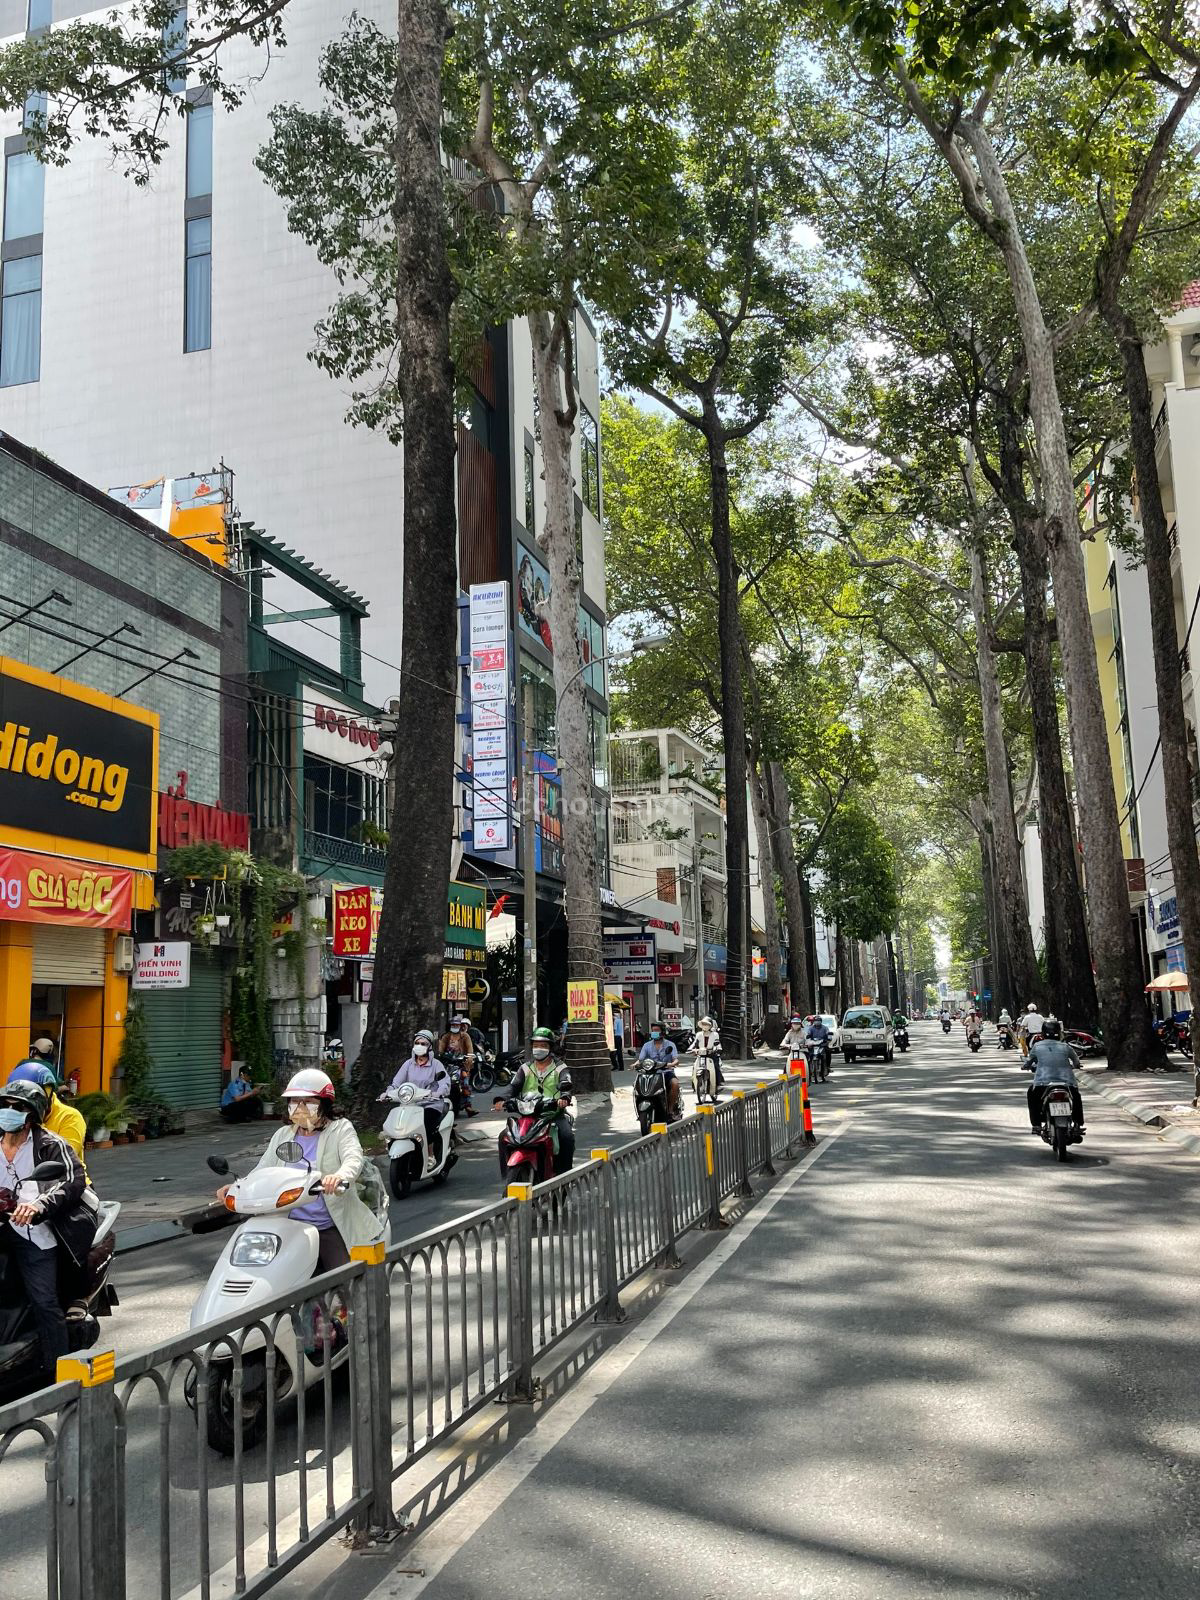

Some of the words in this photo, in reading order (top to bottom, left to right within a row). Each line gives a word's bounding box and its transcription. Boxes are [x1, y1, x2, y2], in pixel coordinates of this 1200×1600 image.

[66, 791, 98, 808] .com
[449, 896, 473, 929] BÁNH
[340, 915, 367, 931] KEO
[342, 937, 361, 953] XE
[139, 970, 180, 978] BUILDING
[586, 988, 595, 1006] XE
[573, 1009, 592, 1019] 126
